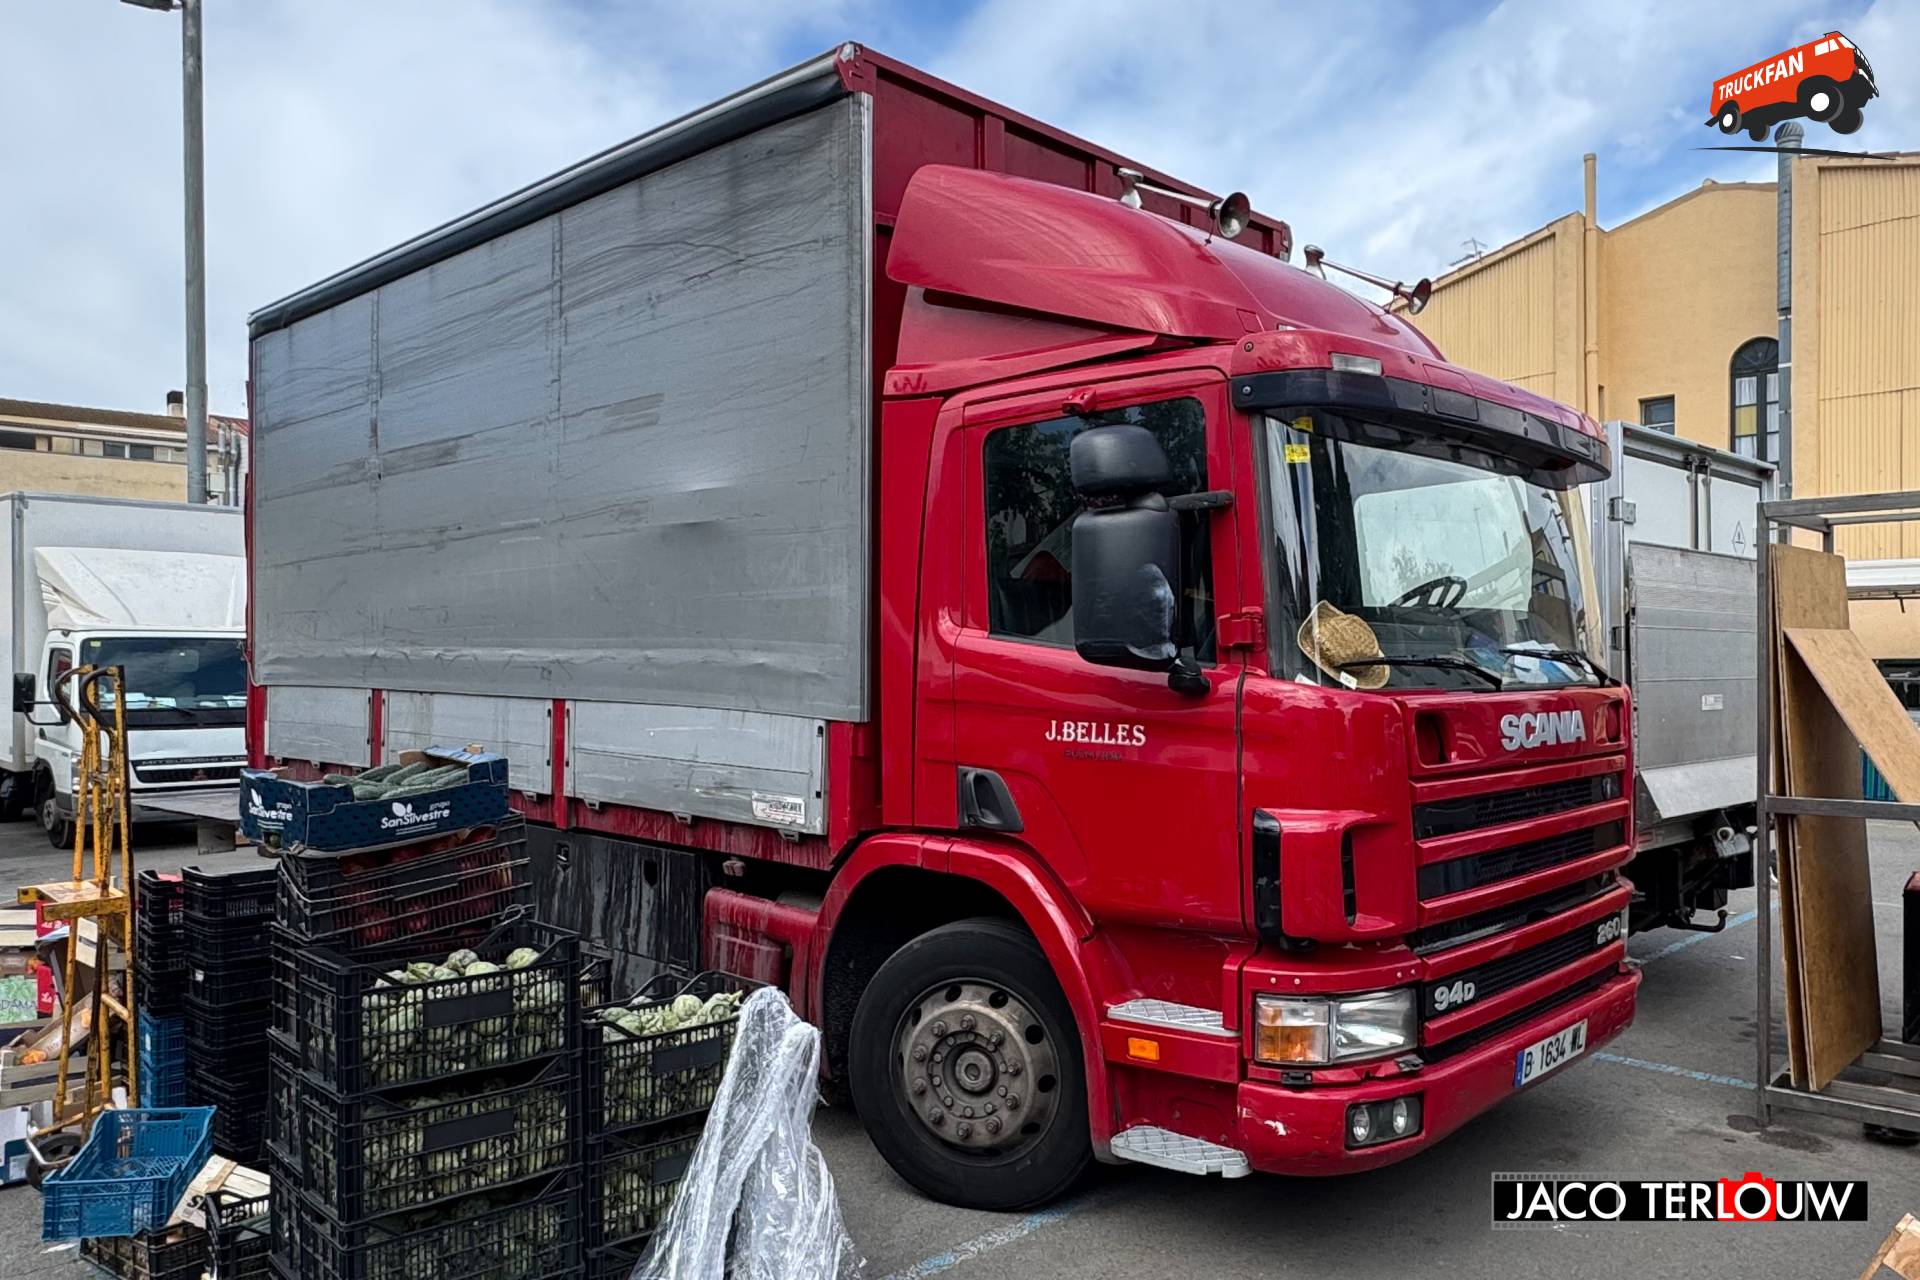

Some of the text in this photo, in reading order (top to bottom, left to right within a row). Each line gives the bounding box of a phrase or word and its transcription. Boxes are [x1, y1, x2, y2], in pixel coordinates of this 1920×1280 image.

[1045, 720, 1146, 747] J.BELLES
[1500, 710, 1587, 751] SCANIA
[380, 809, 450, 829] SanSilvestre
[1597, 917, 1622, 945] 260
[1434, 980, 1476, 1012] 94D
[1523, 1050, 1534, 1080] B
[1540, 1032, 1566, 1071] 1634
